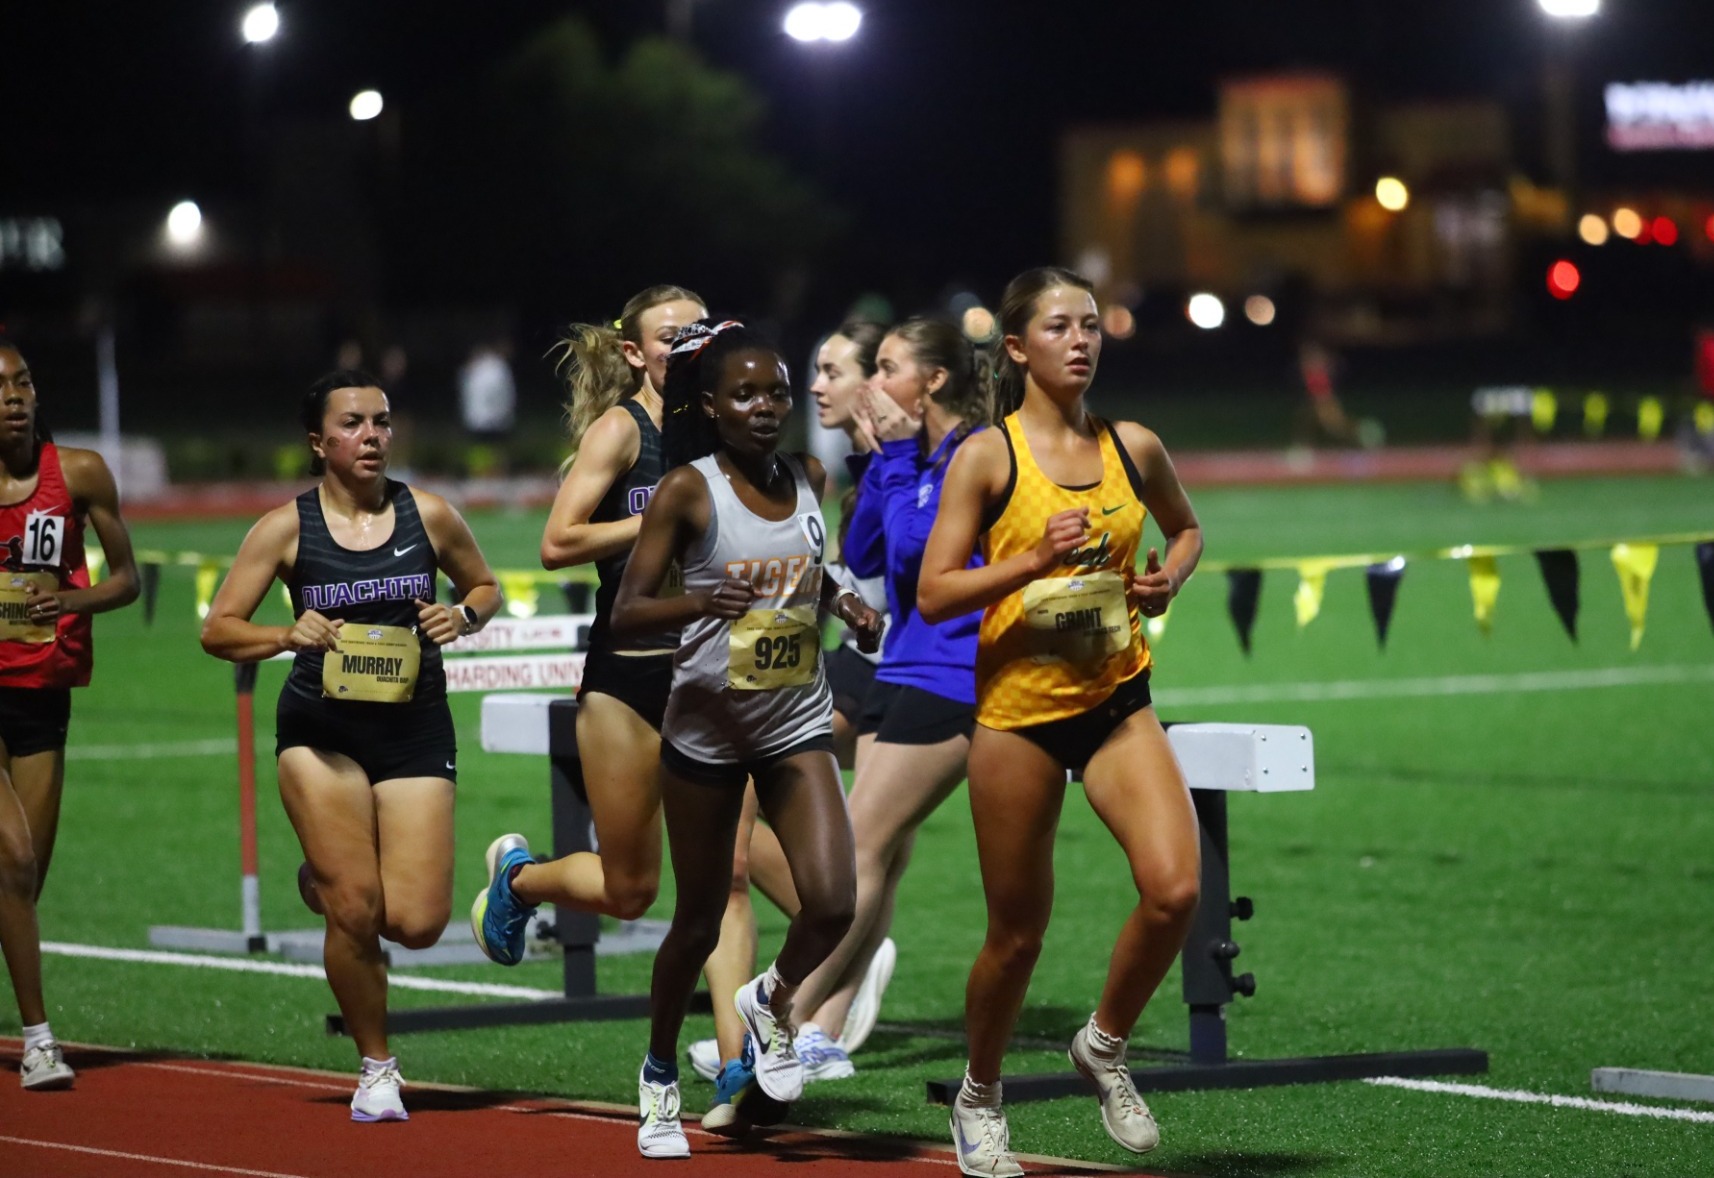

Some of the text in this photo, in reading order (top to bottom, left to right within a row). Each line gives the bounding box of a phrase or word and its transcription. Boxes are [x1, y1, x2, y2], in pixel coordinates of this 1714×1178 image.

[29, 518, 56, 562] 16
[807, 515, 824, 565] 9
[302, 573, 432, 611] OUACHITA
[1055, 606, 1102, 633] GRANT
[342, 654, 403, 677] MURRAY
[754, 633, 801, 671] 925
[447, 664, 532, 689] HARDING
